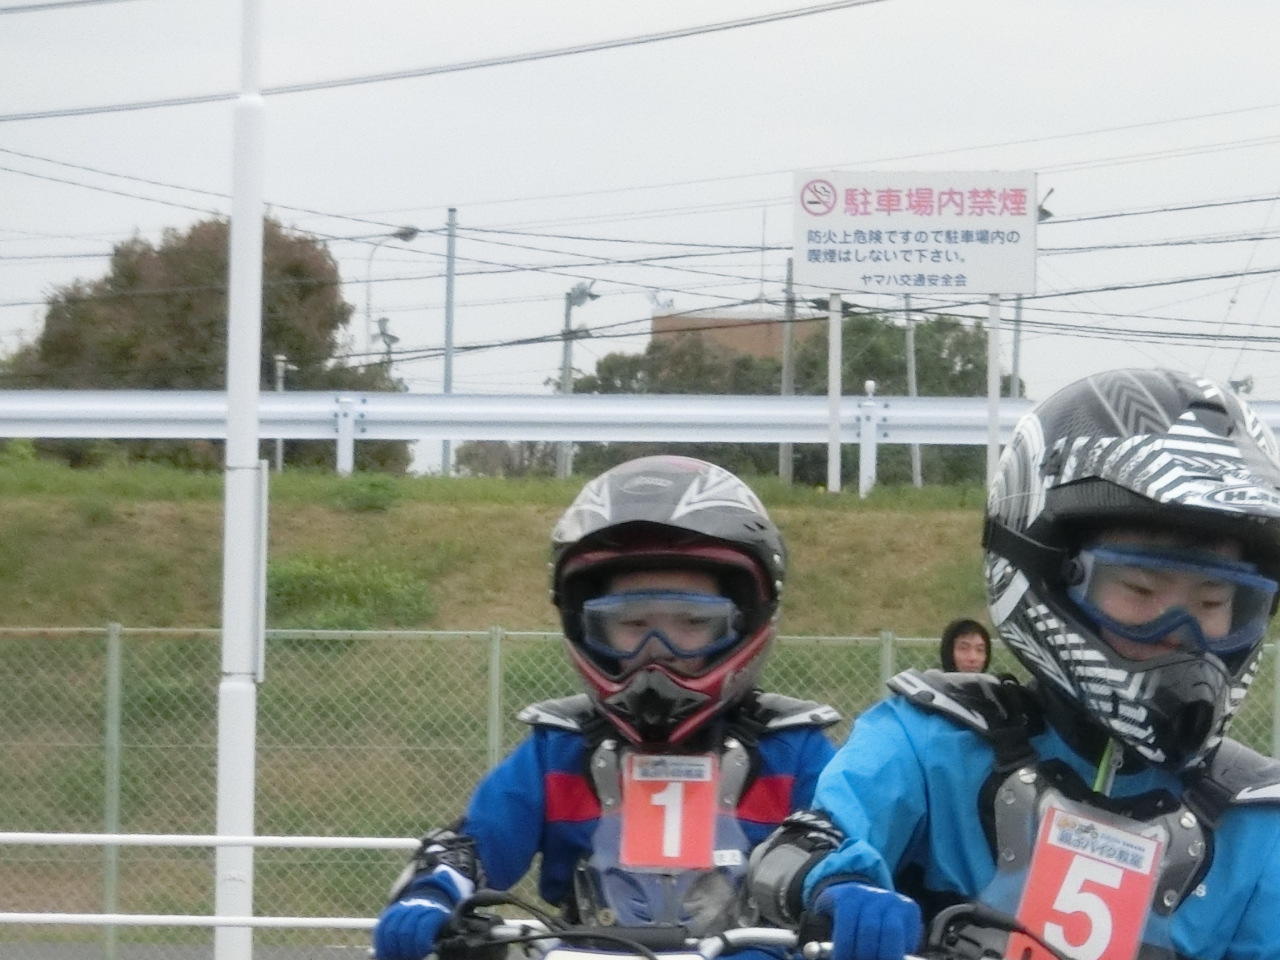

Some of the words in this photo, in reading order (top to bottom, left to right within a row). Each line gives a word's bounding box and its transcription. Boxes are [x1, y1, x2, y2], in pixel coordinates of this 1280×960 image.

[843, 187, 1028, 216] 駐車場内禁煙
[807, 229, 1020, 245] 防火上危険ですので駐車場内の
[807, 249, 966, 263] 喫煙はしないで下さい。
[861, 273, 967, 287] ヤマハ交通安全会
[651, 781, 686, 858] 1
